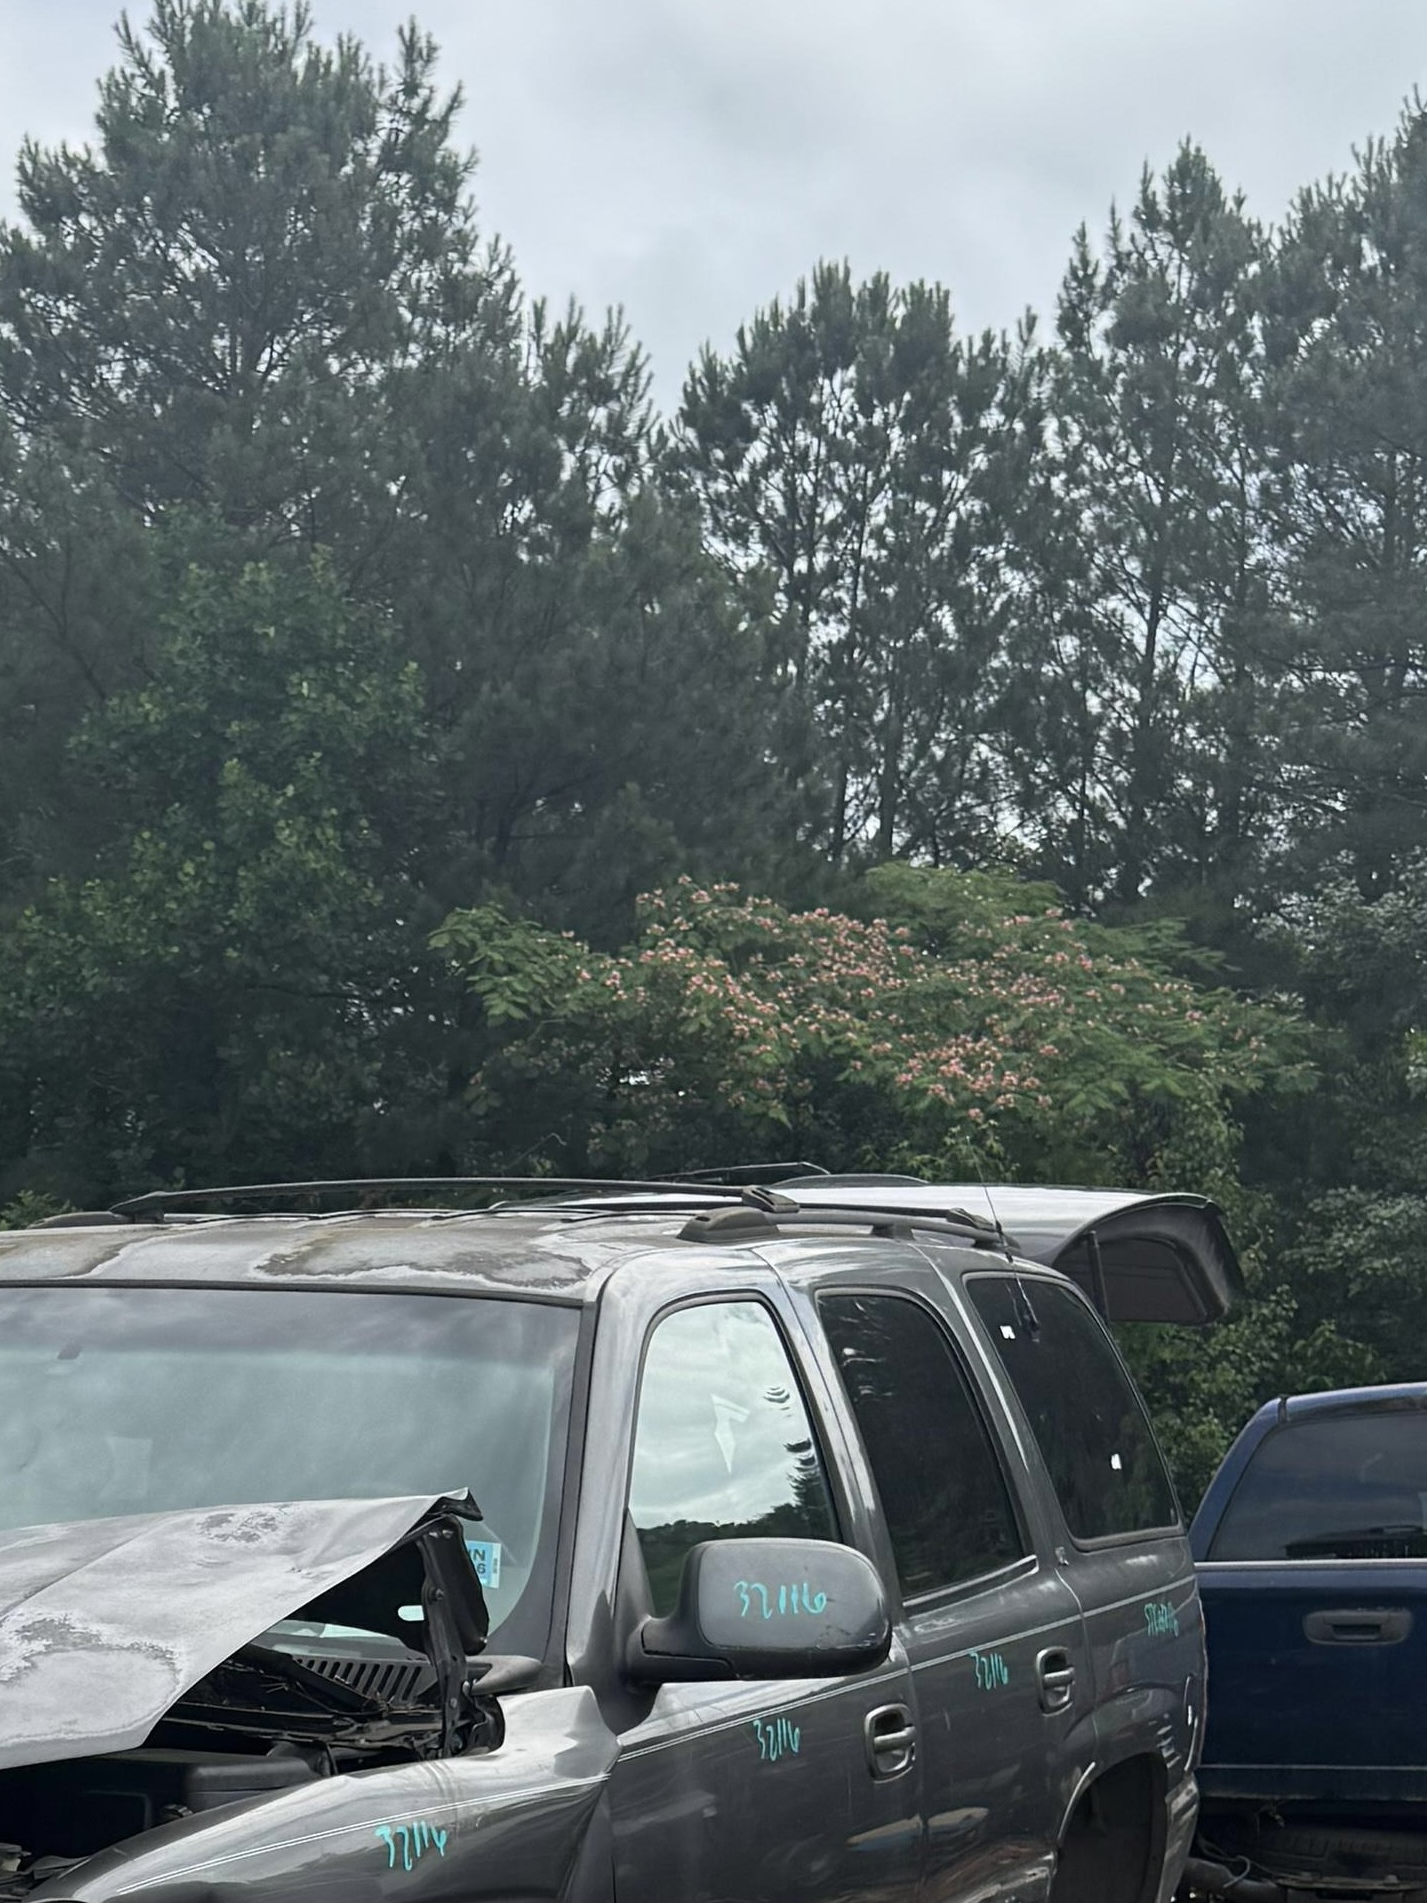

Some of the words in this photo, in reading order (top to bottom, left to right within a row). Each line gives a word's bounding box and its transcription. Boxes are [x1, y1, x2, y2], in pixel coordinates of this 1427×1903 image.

[469, 1549, 486, 1562] N
[734, 1581, 827, 1619] 32116
[753, 1718, 801, 1761] 32116
